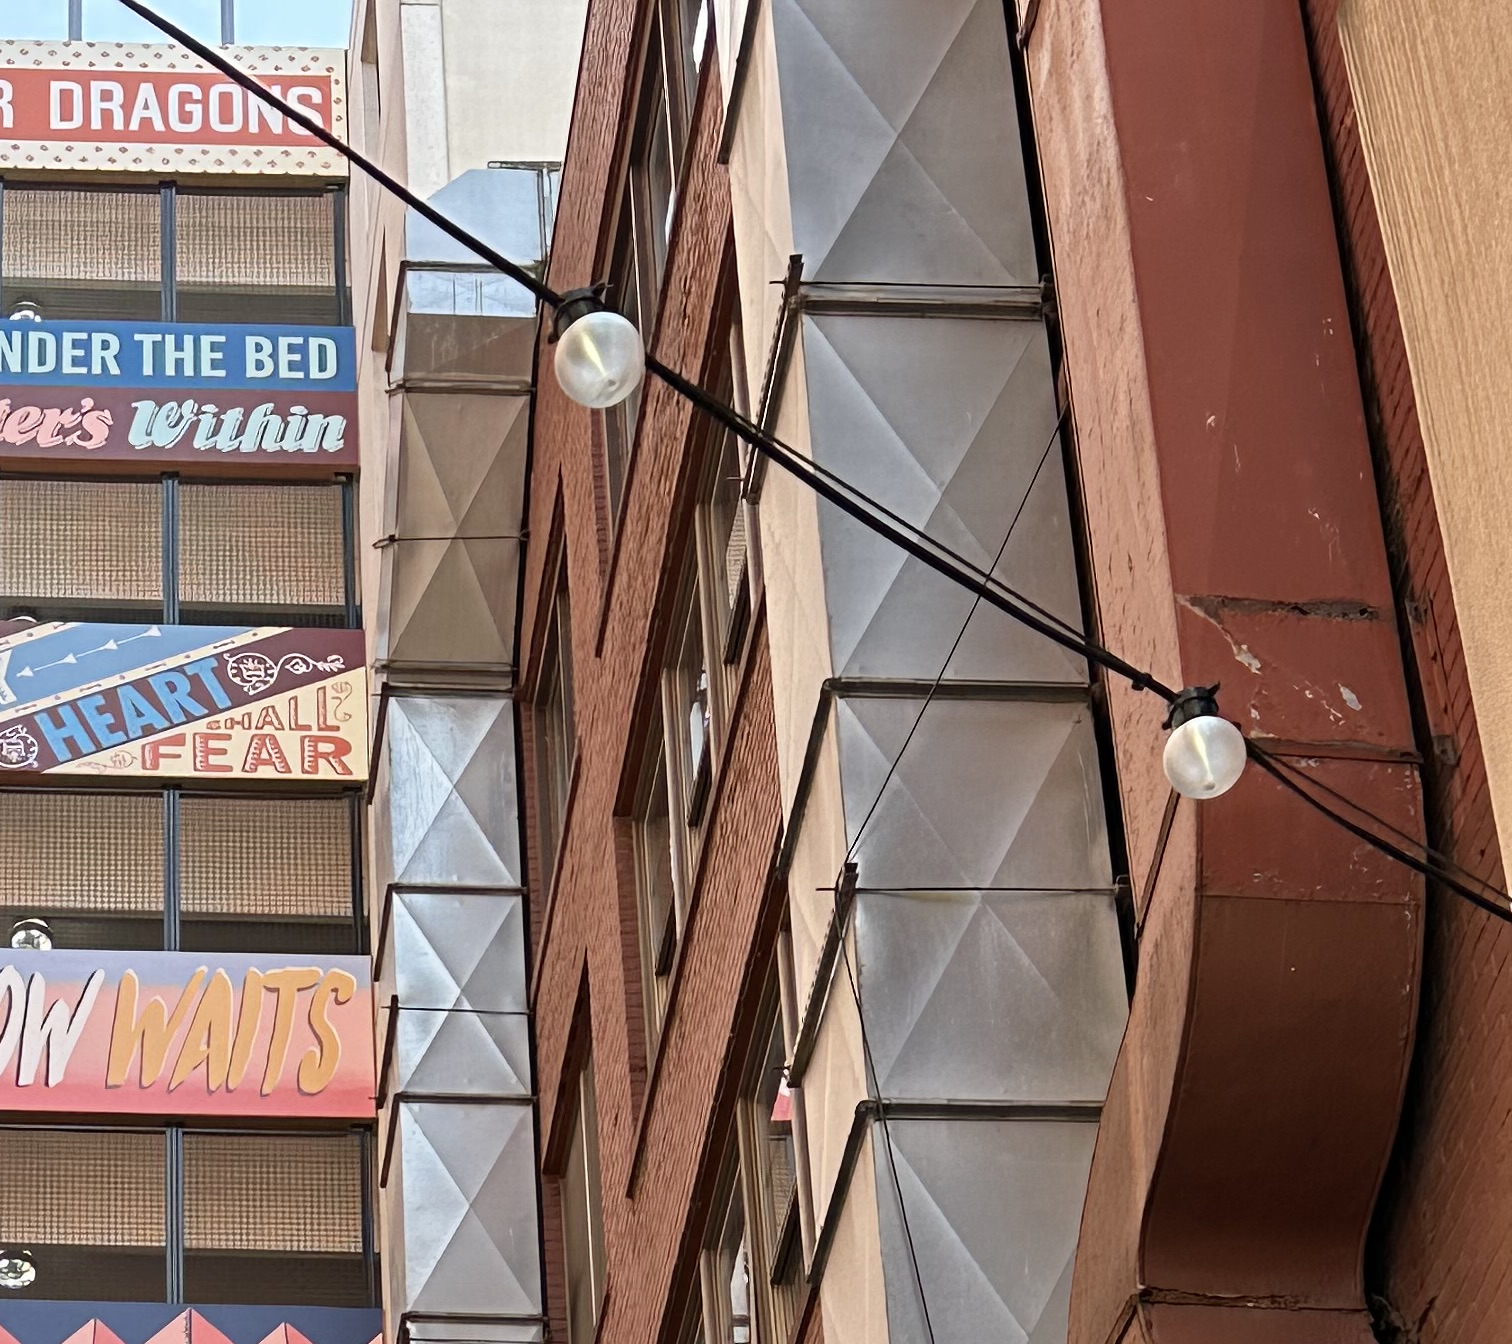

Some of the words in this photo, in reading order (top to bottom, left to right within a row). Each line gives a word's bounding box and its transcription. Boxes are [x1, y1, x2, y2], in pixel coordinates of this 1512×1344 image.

[49, 80, 325, 138] DRAGONS
[132, 333, 227, 380] THE
[244, 336, 338, 381] BED
[128, 399, 348, 456] Within
[34, 654, 235, 763] HEART
[141, 732, 353, 775] FEAR
[105, 965, 359, 1096] WAITS
